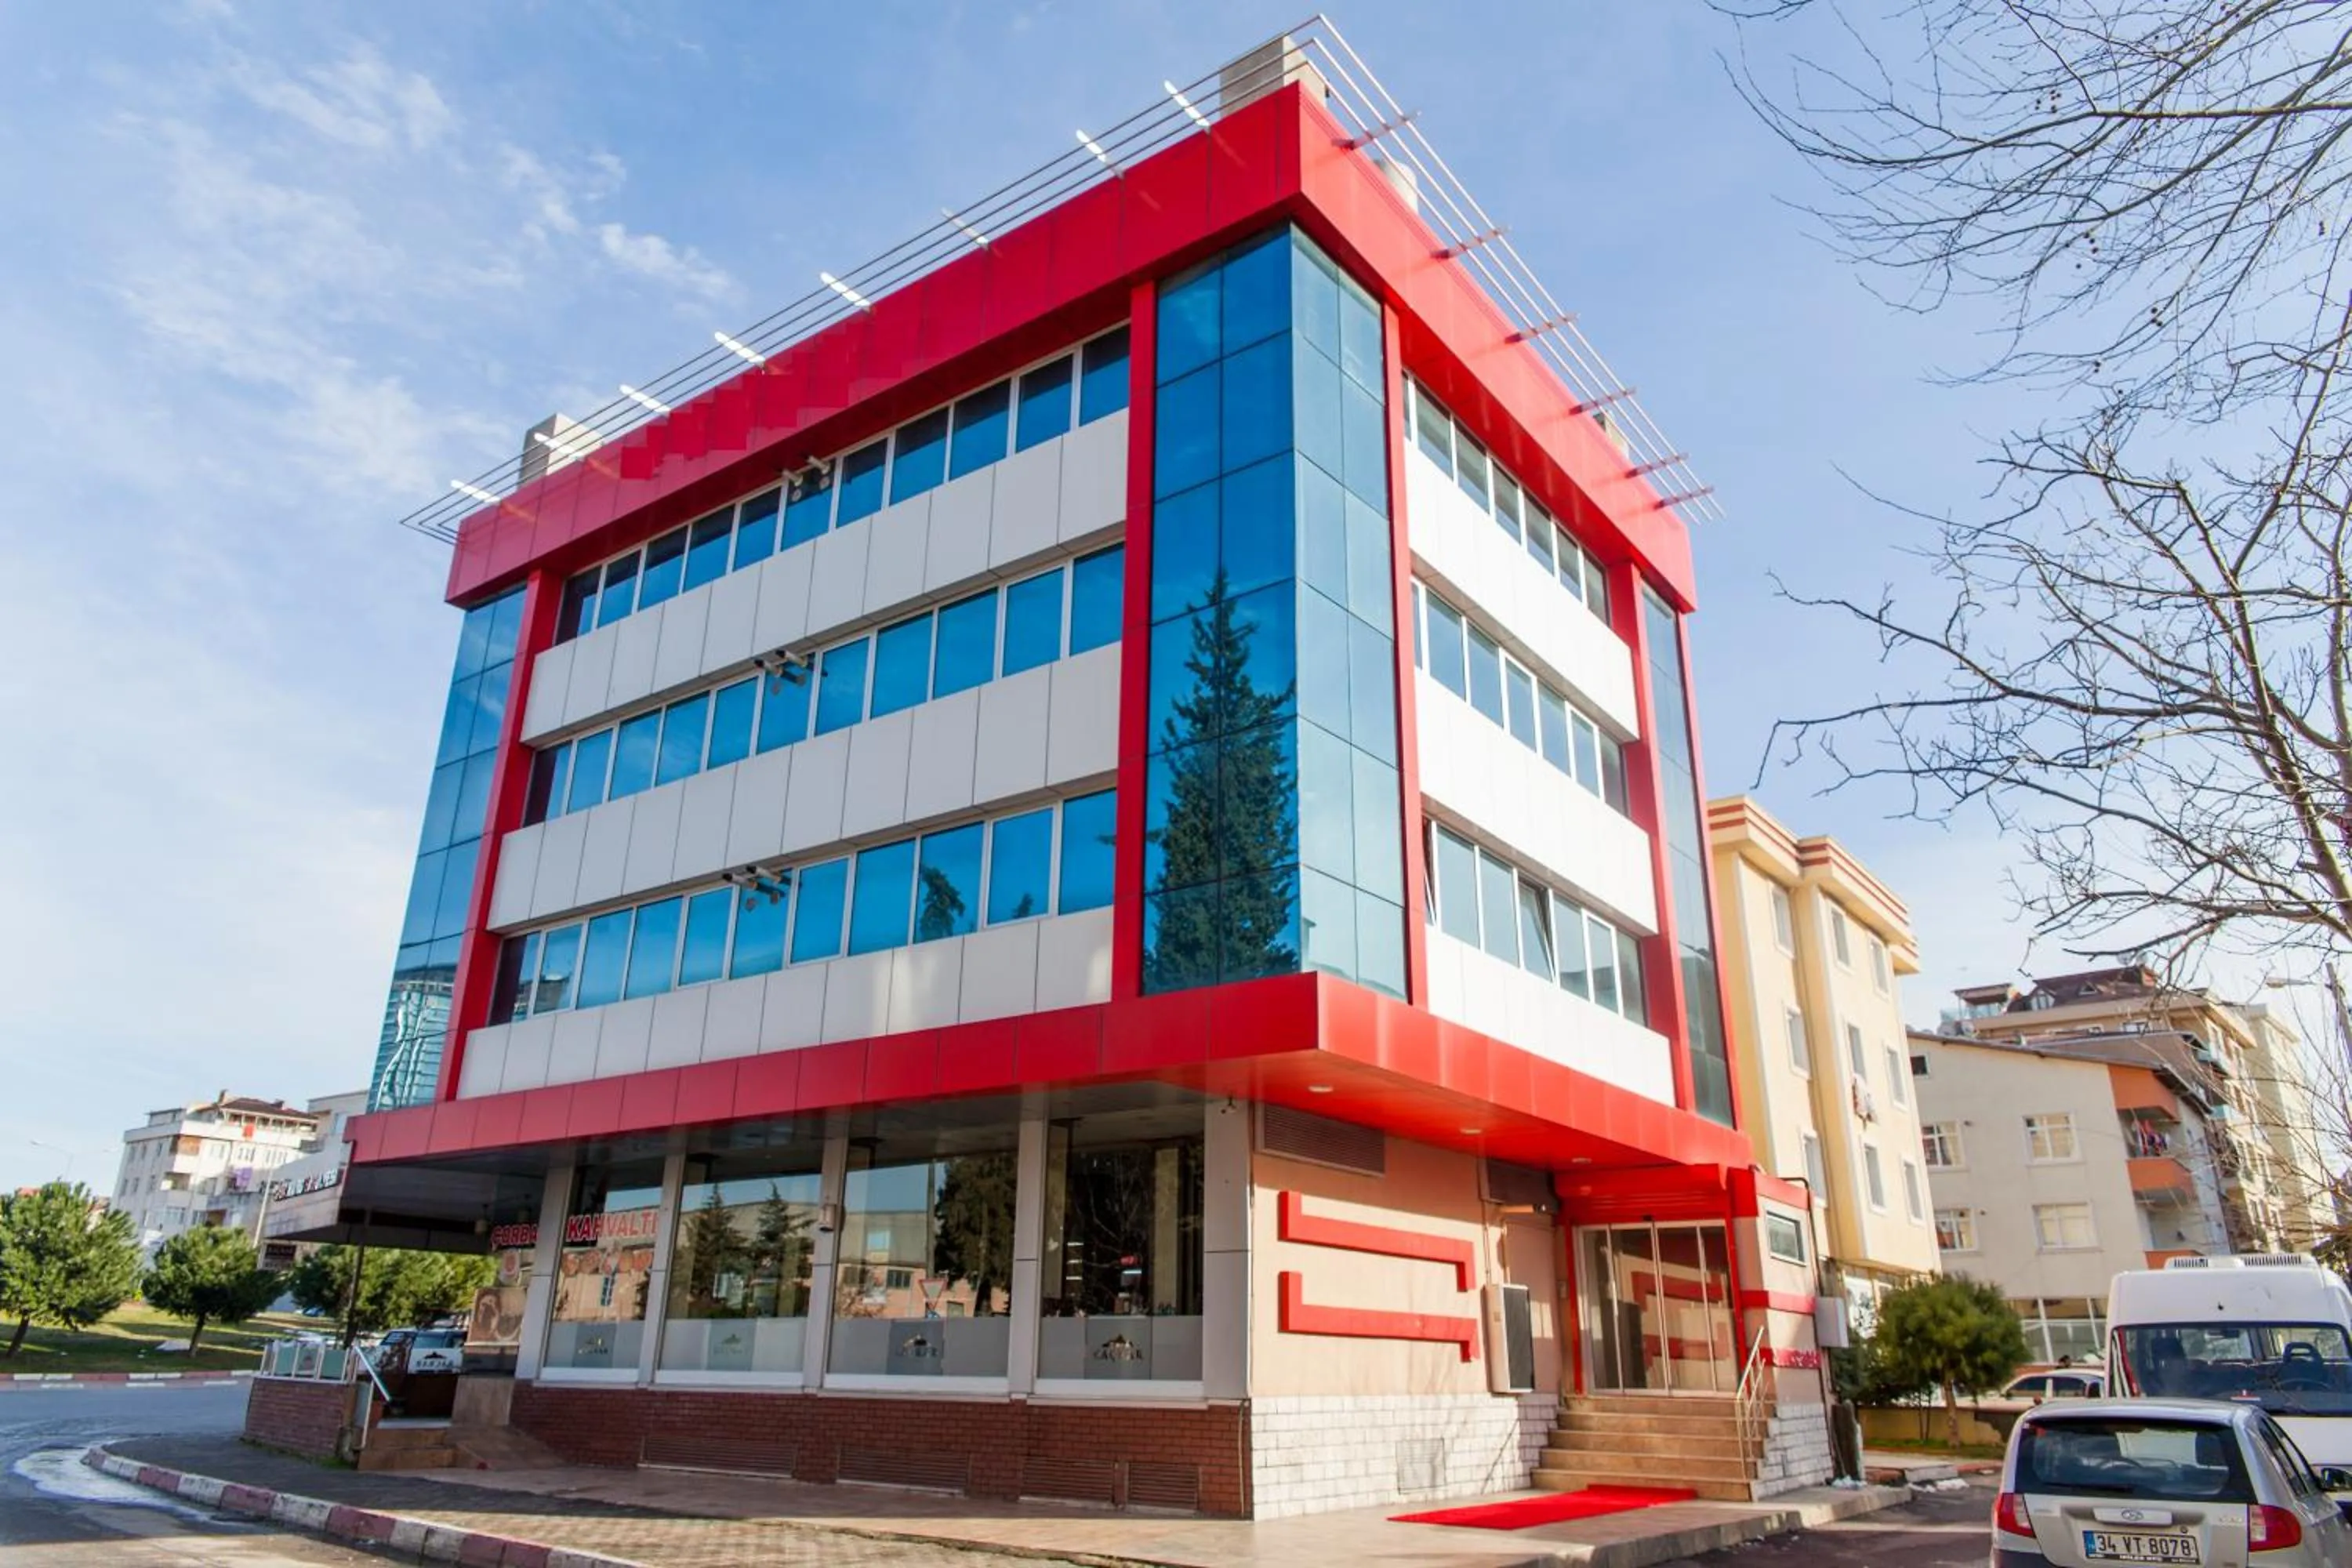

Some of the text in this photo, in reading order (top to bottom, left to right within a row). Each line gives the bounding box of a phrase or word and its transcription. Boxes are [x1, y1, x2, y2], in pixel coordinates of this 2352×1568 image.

[566, 1212, 659, 1242] KAHVALTI
[2097, 1535, 2192, 1556] 34 VT 8078
